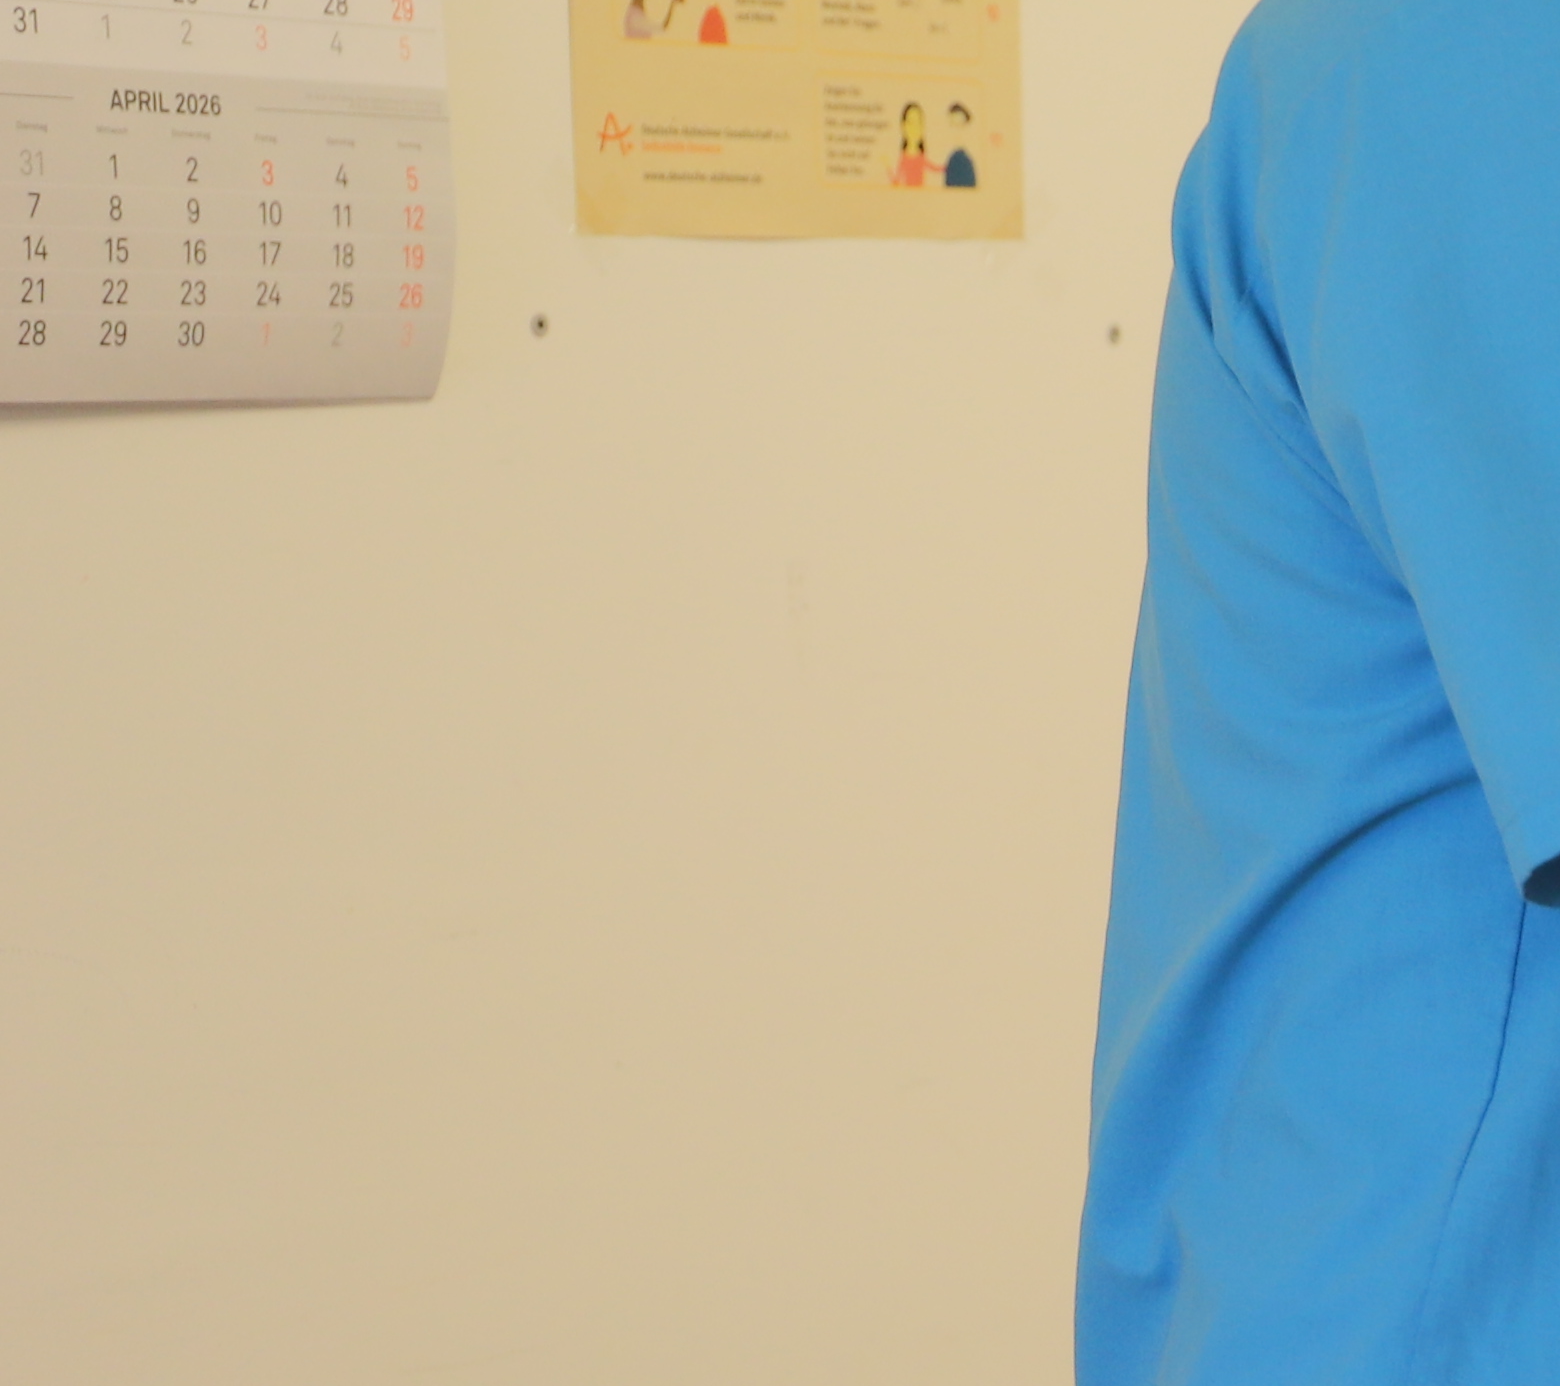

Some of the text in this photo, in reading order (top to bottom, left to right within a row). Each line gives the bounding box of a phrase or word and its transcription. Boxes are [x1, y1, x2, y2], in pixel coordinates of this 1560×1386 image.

[13, 6, 412, 62] 31 1 2 3 4 5
[111, 89, 221, 116] APRIL 2026
[20, 149, 419, 192] 31 1 2 3 4 5
[28, 192, 425, 232] 7 8 9 10 11 12
[23, 235, 425, 271] 14 15 16 17 18 19
[21, 277, 424, 309] 21 22 23 24 25 26
[18, 320, 46, 346] 28
[99, 320, 127, 347] 29
[178, 321, 205, 348] 30
[260, 322, 271, 347] 1
[330, 322, 345, 348] 2
